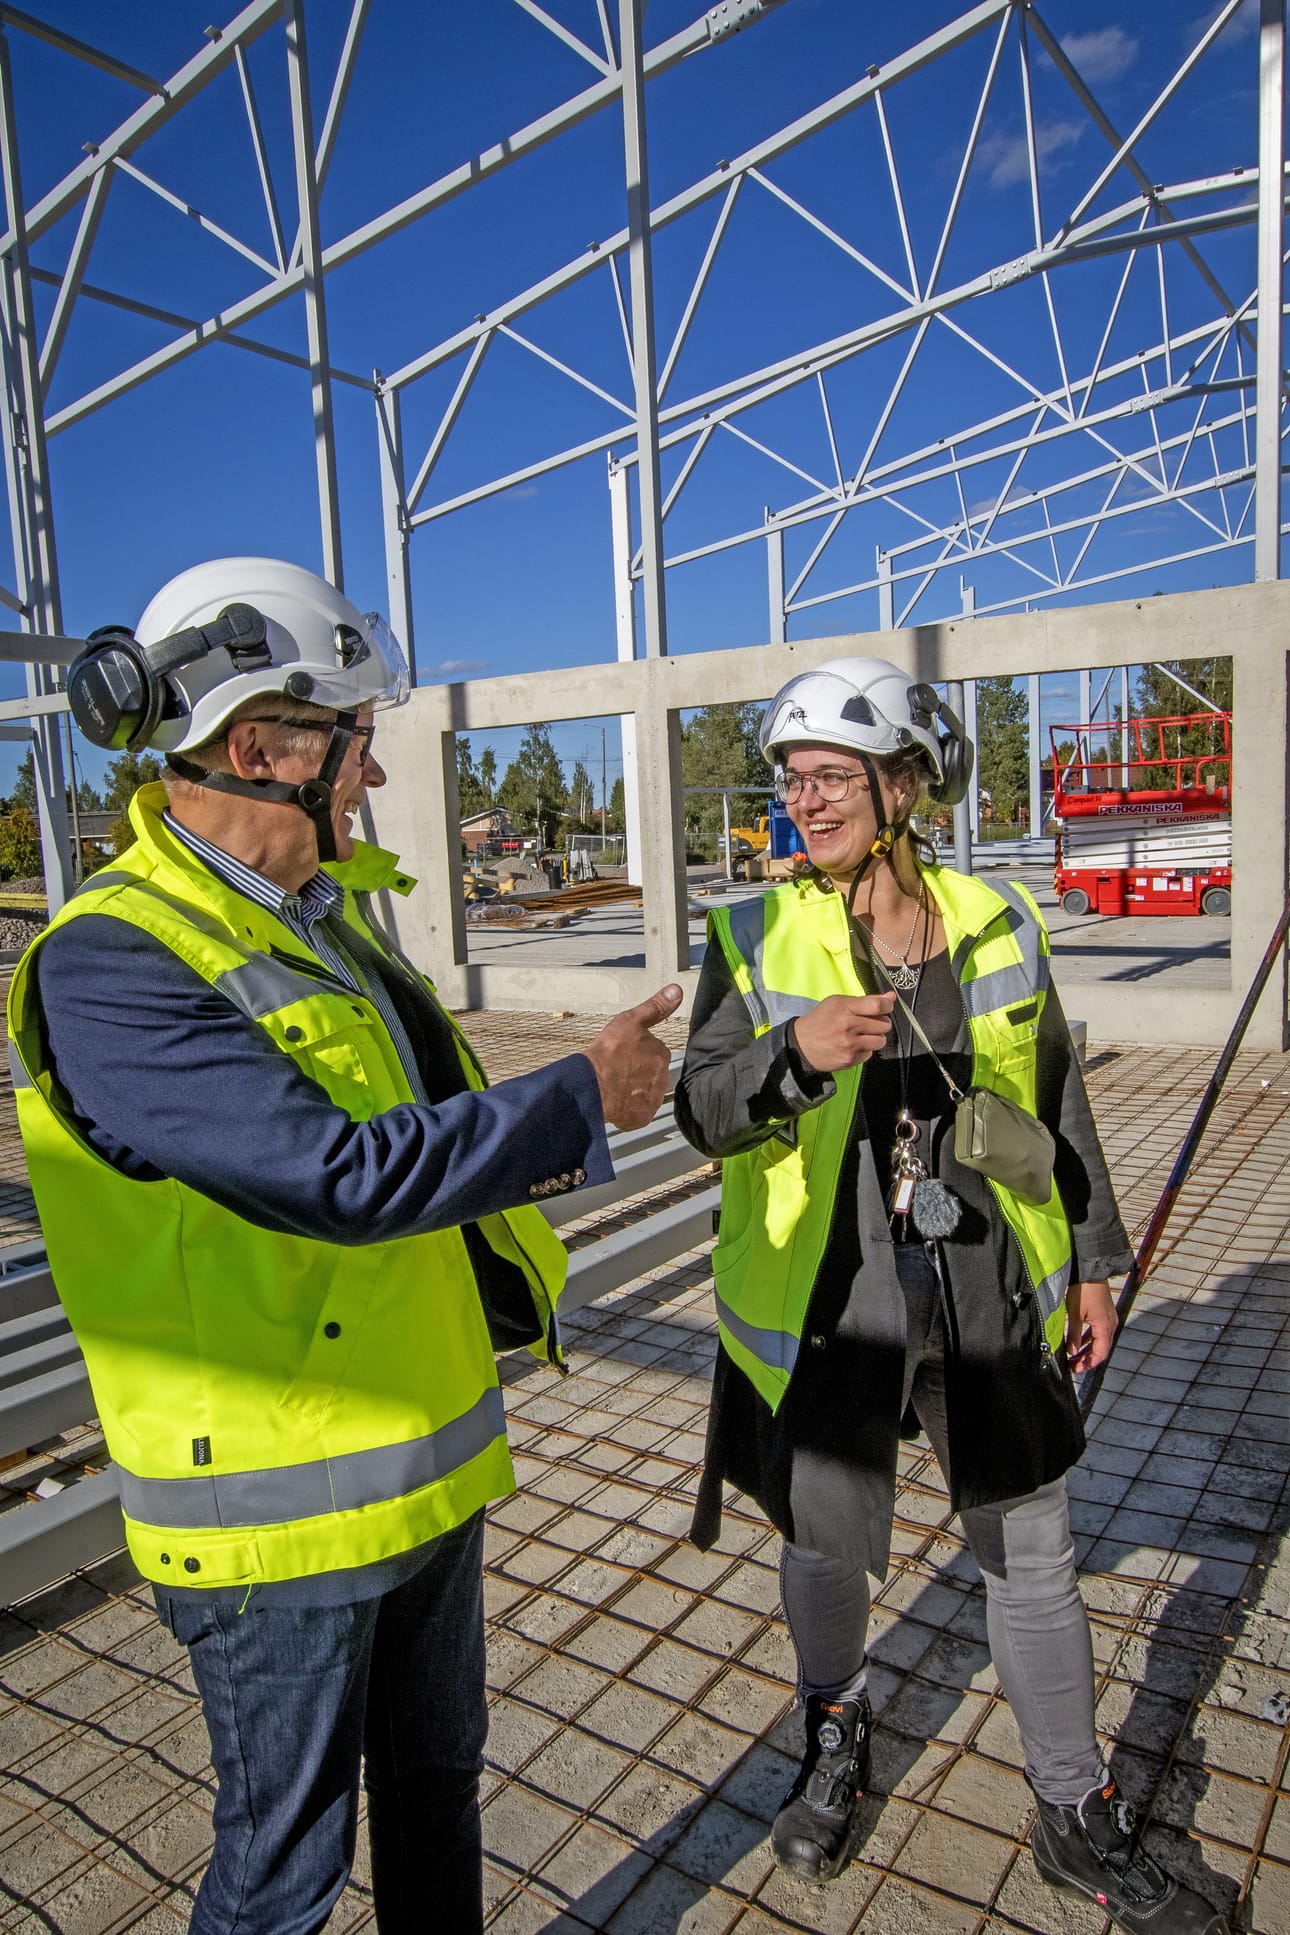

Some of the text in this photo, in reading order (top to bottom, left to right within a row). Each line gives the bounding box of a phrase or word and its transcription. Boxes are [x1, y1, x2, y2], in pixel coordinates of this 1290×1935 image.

[1067, 796, 1094, 805] Compact
[1099, 803, 1182, 815] PEKKANISKA
[1156, 814, 1220, 825] PEKKANISKA
